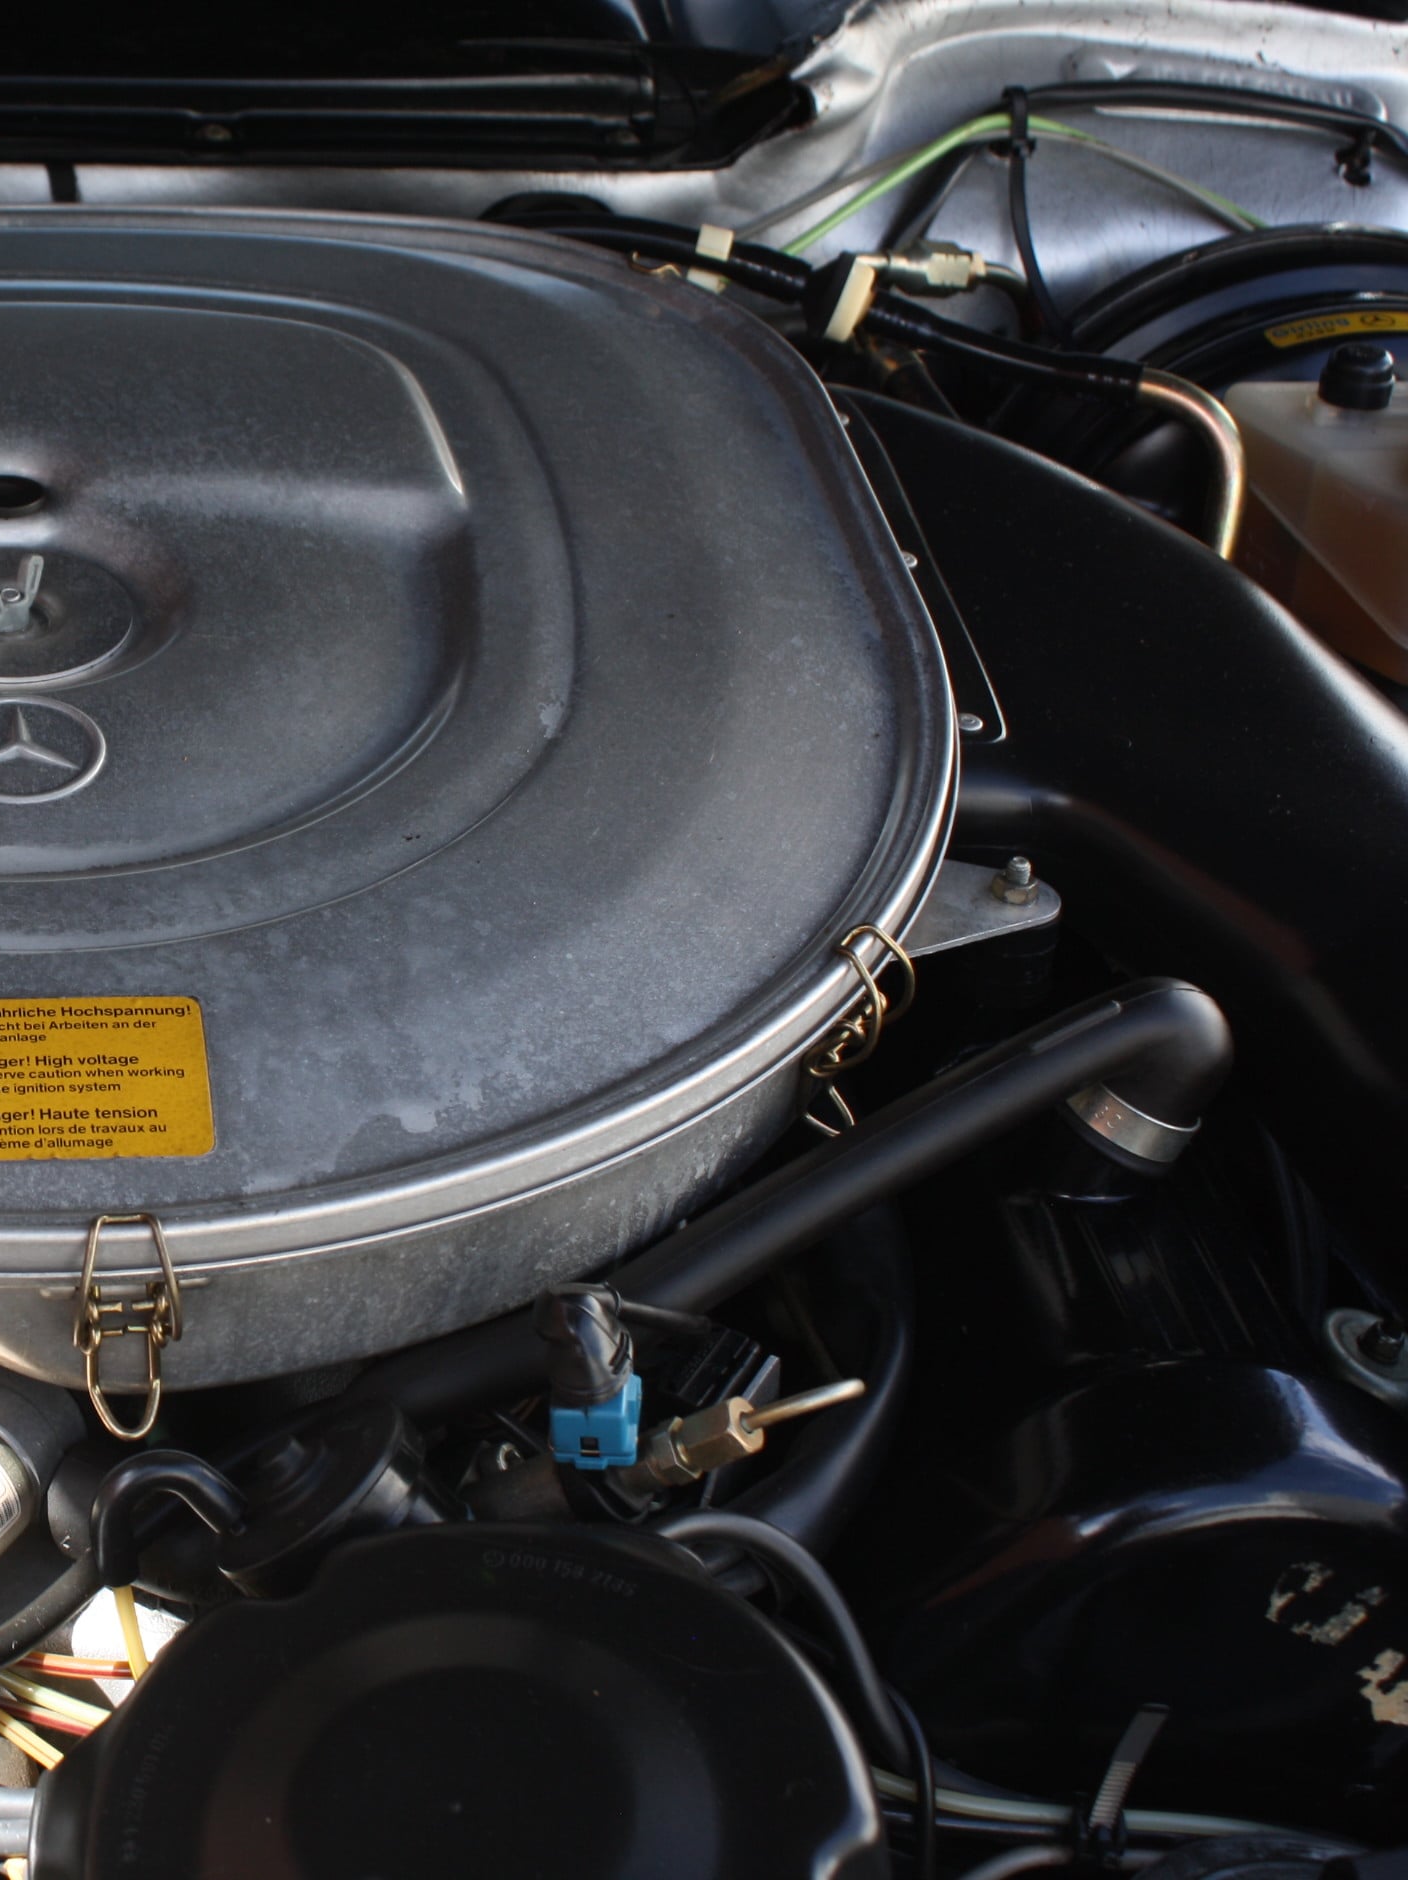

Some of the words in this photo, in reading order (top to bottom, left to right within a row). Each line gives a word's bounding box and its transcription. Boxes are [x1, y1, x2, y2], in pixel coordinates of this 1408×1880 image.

[60, 1004, 192, 1018] Hochspannung!
[23, 1021, 45, 1031] bei
[48, 1020, 109, 1030] Arbeiten
[111, 1021, 130, 1029] an
[132, 1019, 156, 1029] der
[34, 1055, 73, 1068] High
[77, 1054, 139, 1067] voltage
[28, 1068, 82, 1079] caution
[85, 1067, 124, 1078] when
[126, 1066, 186, 1079] working
[13, 1083, 65, 1096] ignition
[68, 1082, 121, 1094] system
[39, 1108, 90, 1121] Haute
[94, 1106, 158, 1119] tension
[38, 1123, 65, 1135] lors
[68, 1122, 87, 1134] de
[90, 1124, 145, 1134] travaux
[149, 1124, 167, 1133] au
[34, 1137, 114, 1149] d'allumage
